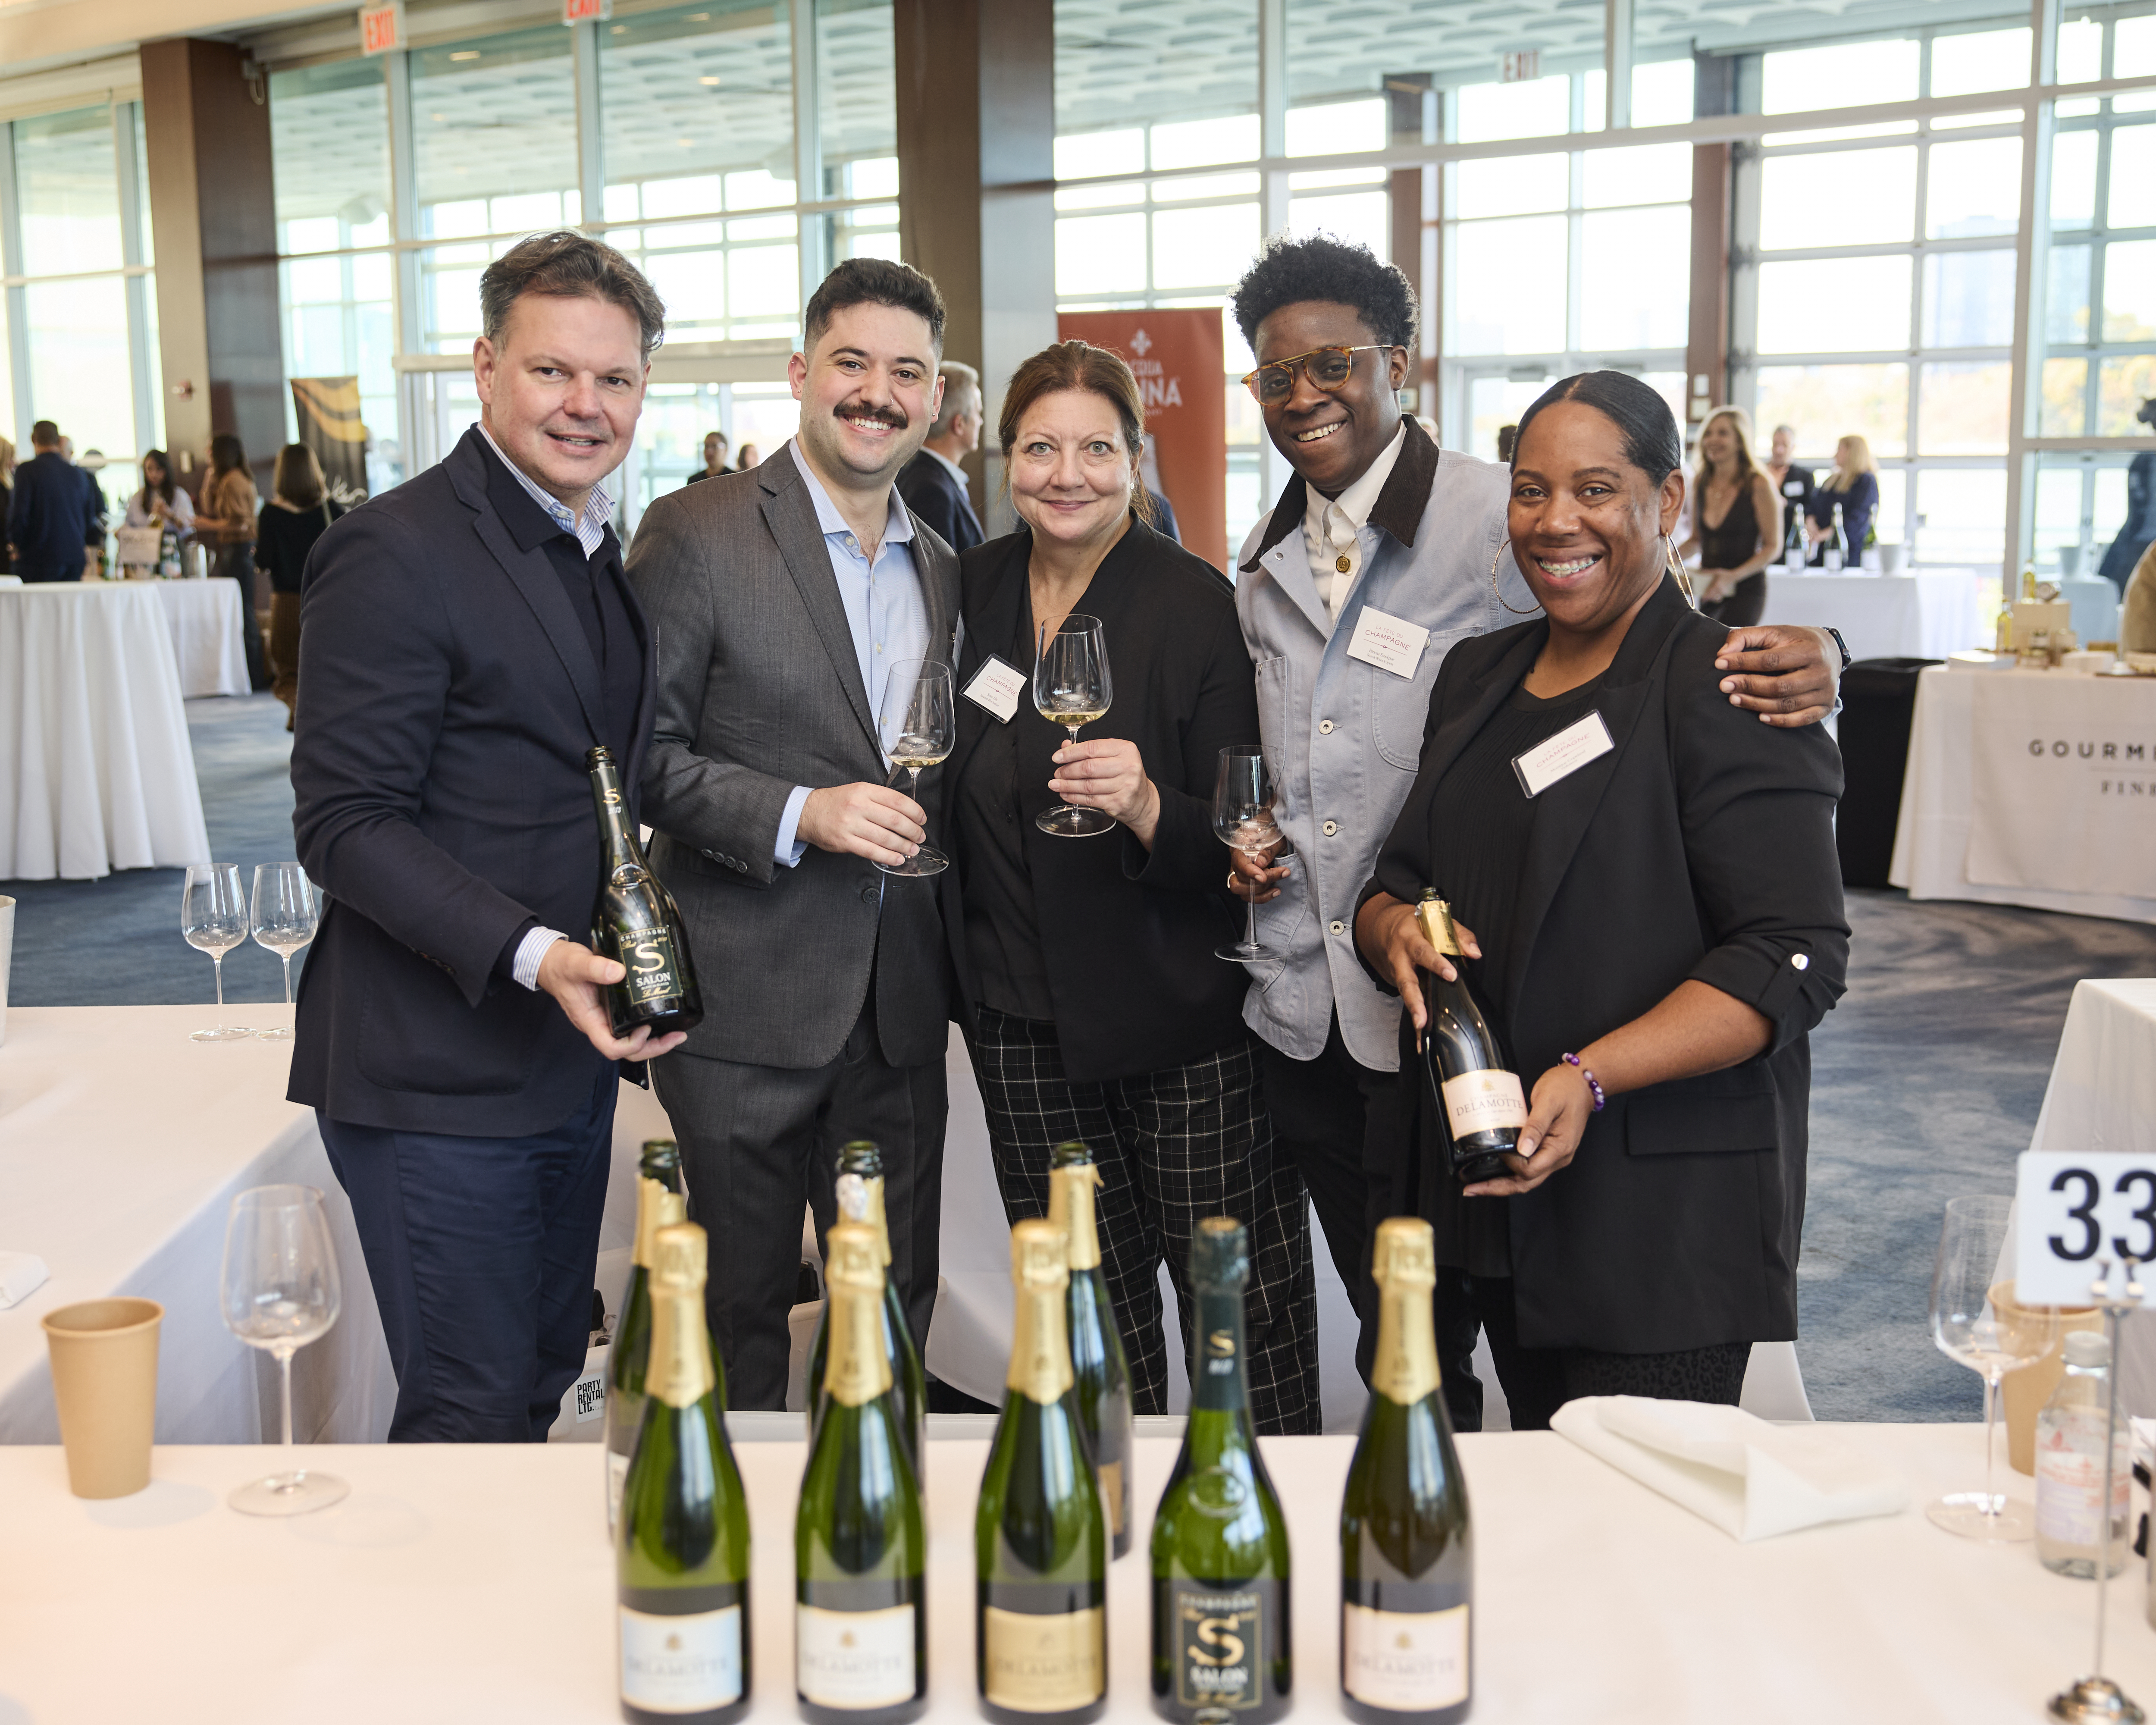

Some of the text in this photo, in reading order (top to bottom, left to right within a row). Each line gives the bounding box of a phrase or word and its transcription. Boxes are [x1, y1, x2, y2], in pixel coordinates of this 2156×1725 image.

[365, 10, 395, 52] EXIT
[1365, 630, 1411, 651] CHAMPAGNE
[986, 676, 1018, 696] CHAMPAGNE
[1536, 733, 1590, 767] CHAMPAGNE
[2028, 739, 2156, 762] GOURM
[603, 787, 620, 804] S
[620, 928, 666, 942] CHAMPAGNE
[632, 939, 665, 975] S
[636, 972, 671, 987] SALON
[1457, 1098, 1523, 1116] DELAMOTTE
[2048, 1167, 2156, 1262] 33
[577, 1379, 600, 1394] PARTY
[578, 1389, 605, 1404] RENTAL
[579, 1402, 594, 1414] LTD.
[1188, 1613, 1244, 1666] S
